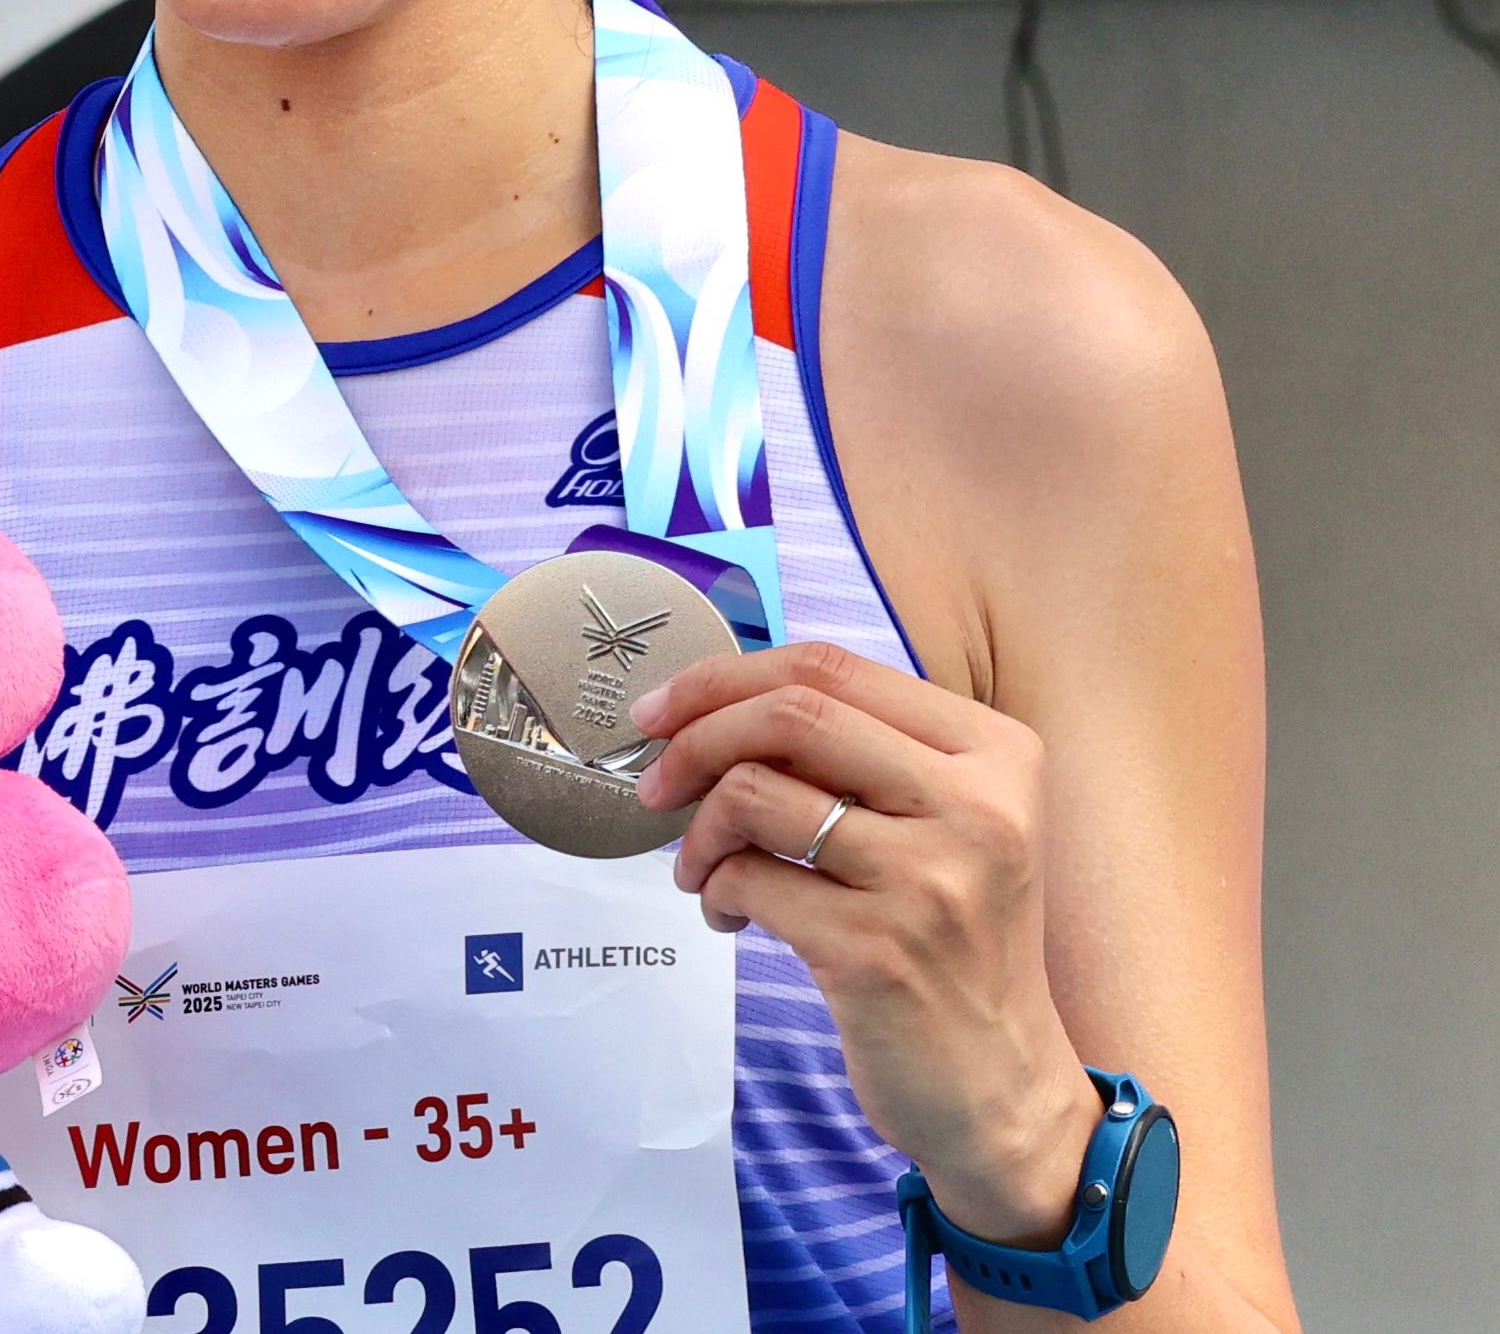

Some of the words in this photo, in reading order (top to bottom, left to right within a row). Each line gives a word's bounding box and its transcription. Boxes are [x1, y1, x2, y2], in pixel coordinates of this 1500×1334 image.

[572, 702, 618, 729] 2025
[533, 943, 677, 971] ATHLETICS
[182, 981, 222, 995] WORLD
[225, 978, 278, 992] MASTERS
[281, 974, 320, 987] GAMES
[183, 996, 223, 1014] 2025
[226, 994, 247, 1002] TAIPEI
[248, 992, 263, 1000] CITY
[226, 1003, 242, 1011] NEW
[243, 1001, 265, 1010] TAIPEI
[266, 1000, 281, 1008] CITY
[67, 1118, 341, 1190] Women
[412, 1092, 538, 1163] 35+
